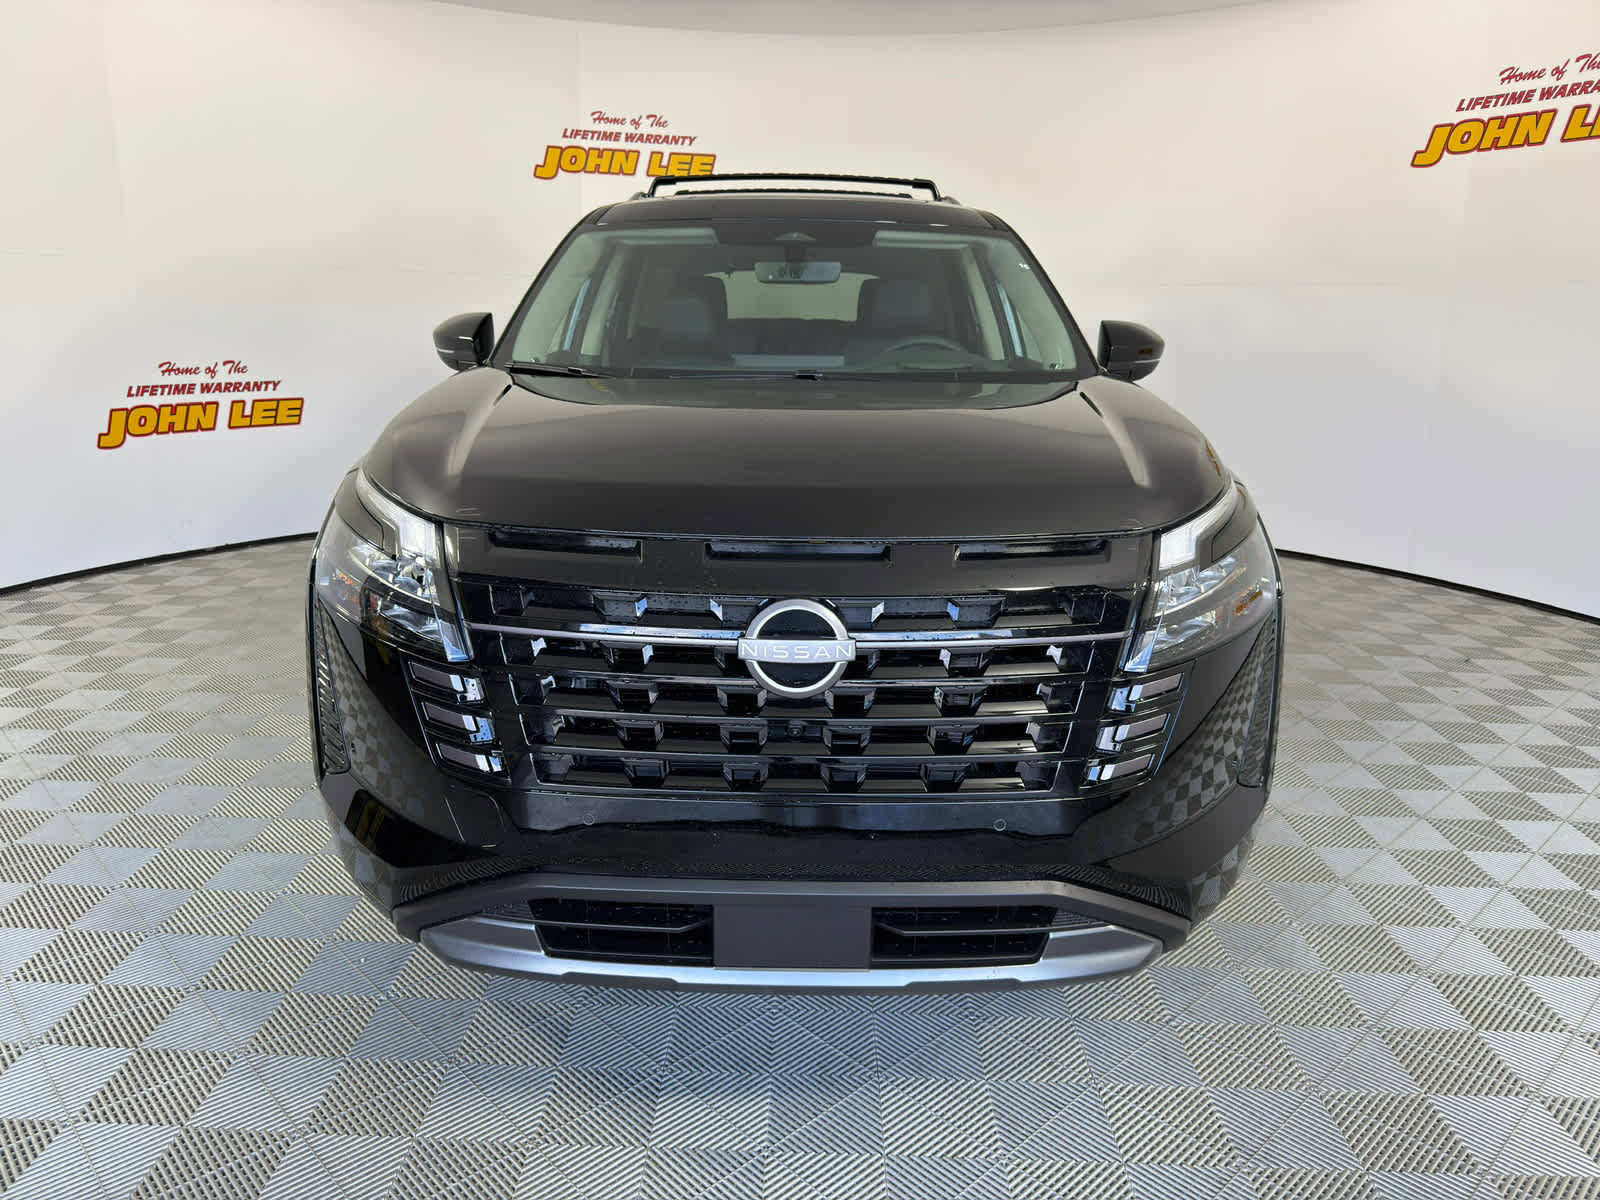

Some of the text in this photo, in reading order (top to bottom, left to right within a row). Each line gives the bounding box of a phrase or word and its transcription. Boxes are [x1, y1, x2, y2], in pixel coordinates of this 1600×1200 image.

[1499, 66, 1546, 85] Home
[1551, 58, 1570, 81] of
[1456, 88, 1536, 112] LIFETIME
[590, 110, 669, 130] Home of The
[562, 128, 696, 147] LIFETIME WARRANTY
[1410, 108, 1558, 168] JOHN
[533, 145, 716, 180] JOHN LEE
[158, 360, 248, 379] Home of The
[127, 380, 281, 398] LIFETIME WARRANTY
[97, 397, 304, 450] JOHN LEE
[741, 642, 852, 659] NISSAN
